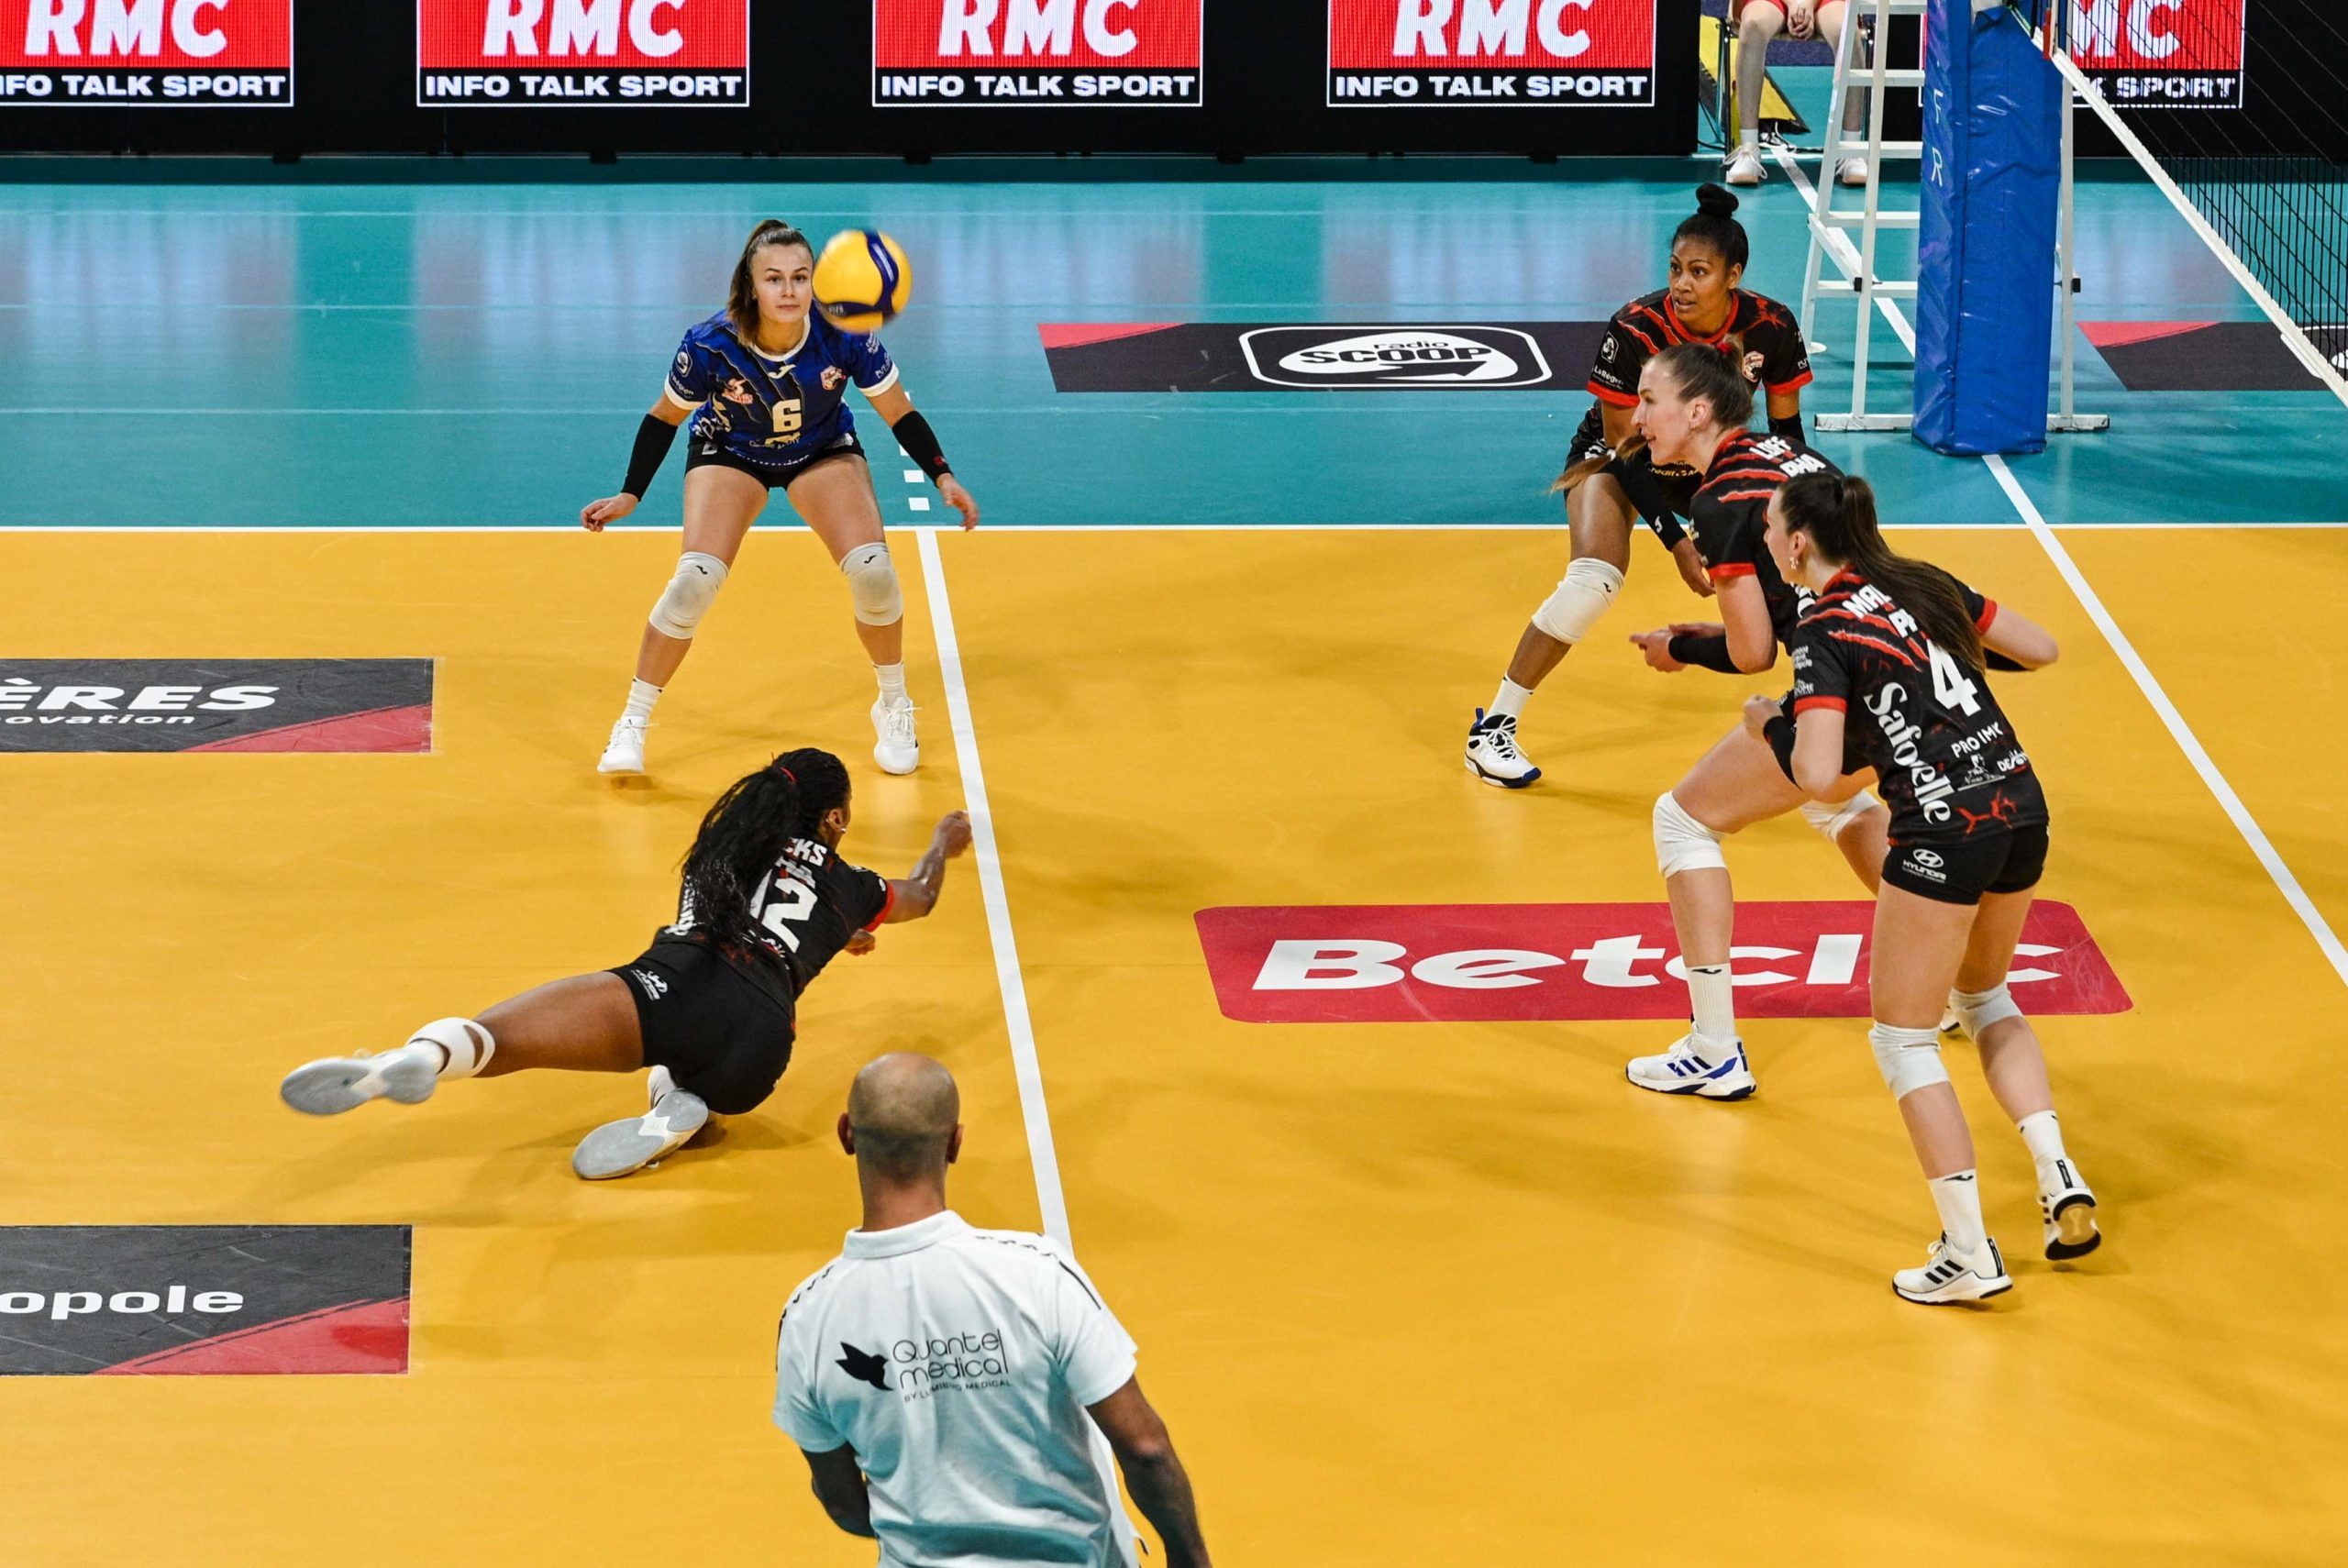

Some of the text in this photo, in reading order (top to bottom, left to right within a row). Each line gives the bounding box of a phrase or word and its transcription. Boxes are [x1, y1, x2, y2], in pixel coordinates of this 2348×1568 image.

[25, 0, 228, 58] RMC
[482, 0, 685, 58] RMC
[937, 0, 1140, 58] RMC
[1392, 0, 1595, 58] RMC
[2073, 0, 2183, 59] MC
[0, 74, 286, 96] FO TALK SPORT
[426, 75, 742, 96] INFO TALK SPORT
[881, 75, 1195, 96] INFO TALK SPORT
[1335, 75, 1648, 96] INFO TALK SPORT
[2116, 76, 2236, 98] SPORT
[1299, 347, 1492, 363] SCOOP
[772, 398, 802, 433] 6
[0, 678, 280, 711] ÈRES
[1926, 638, 1981, 717] 4
[0, 713, 195, 724] ovation
[1951, 736, 1981, 758] PRO
[1252, 933, 2065, 991] Betcl
[0, 1285, 244, 1320] opole
[892, 1329, 1004, 1364] Quantel
[899, 1356, 1008, 1390] medical
